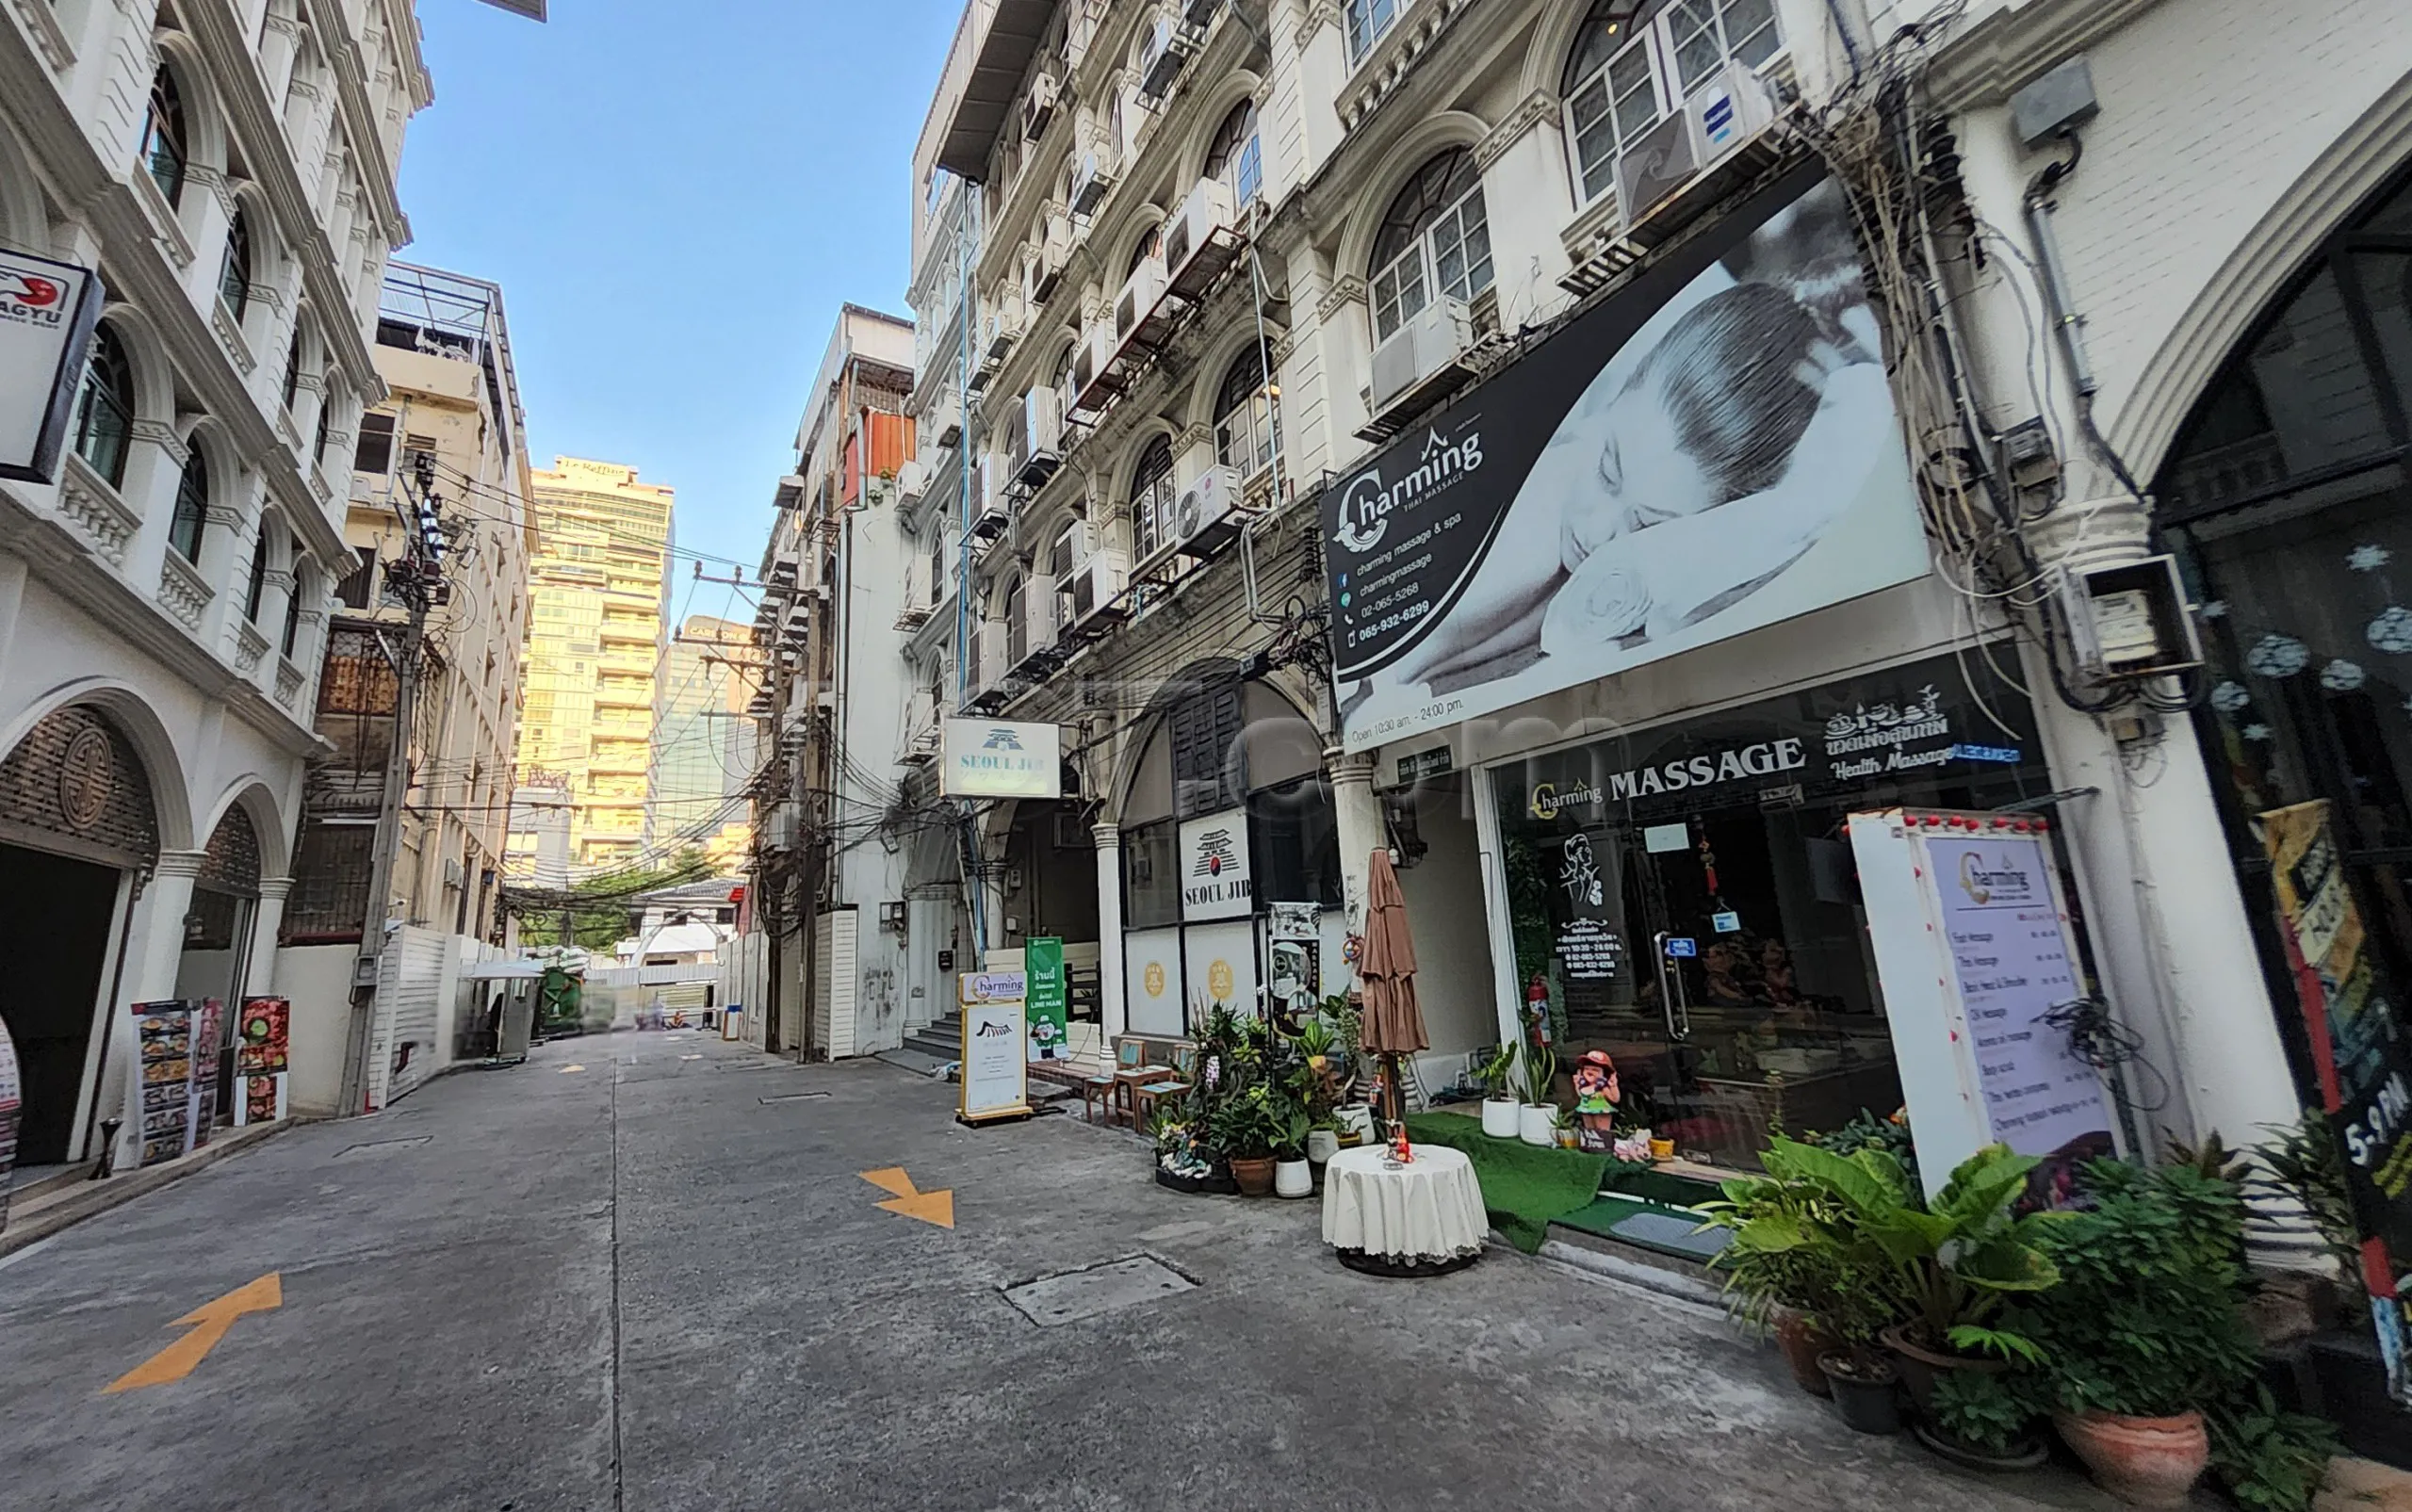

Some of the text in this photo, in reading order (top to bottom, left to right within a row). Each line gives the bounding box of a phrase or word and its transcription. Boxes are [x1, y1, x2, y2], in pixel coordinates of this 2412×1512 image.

[1333, 431, 1483, 552] Charming
[1402, 471, 1463, 512] THAI MASSAGE
[1357, 512, 1461, 576] charming massage & spa
[1360, 553, 1432, 597] charmingmassage
[1359, 600, 1429, 641] 065-932-6299
[1361, 582, 1419, 618] 02-065-5268
[1352, 729, 1372, 744] Open
[1375, 719, 1394, 735] 10:30
[1420, 702, 1443, 721] 24:00
[960, 754, 1014, 771] SEOUL
[1529, 737, 1806, 820] Charming MASSAGE
[1830, 757, 1882, 781] Health
[1884, 746, 1955, 772] Massage
[1185, 878, 1251, 907] SEOUL JIB
[971, 974, 1024, 1000] Charming
